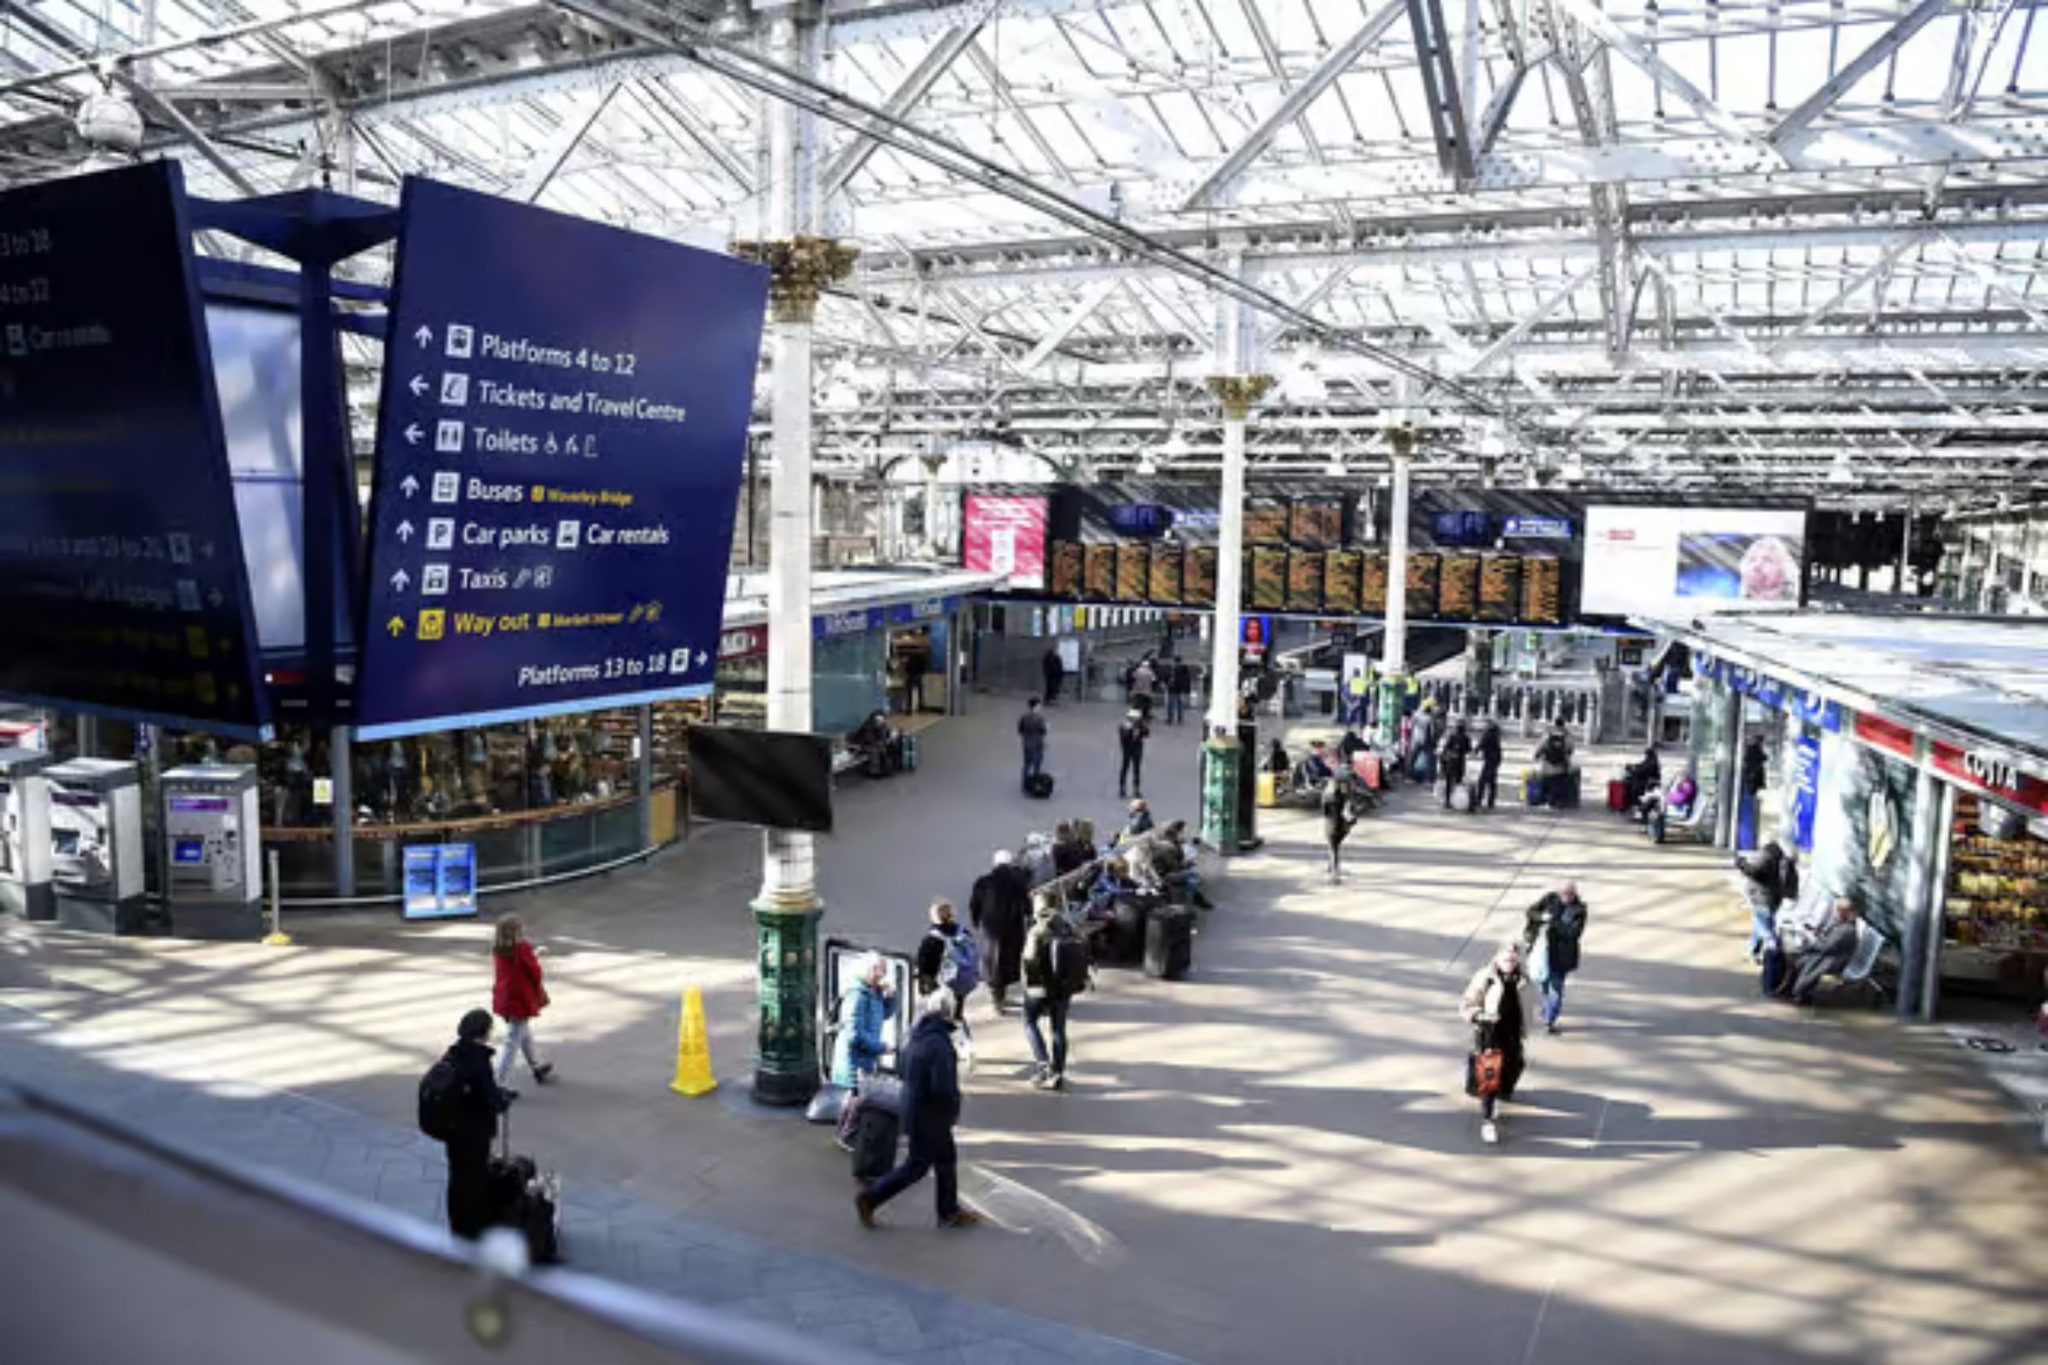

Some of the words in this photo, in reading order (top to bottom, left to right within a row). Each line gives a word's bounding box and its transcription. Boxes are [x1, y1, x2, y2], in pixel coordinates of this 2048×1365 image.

[481, 334, 572, 368] Platforms
[576, 351, 587, 368] 4
[592, 353, 611, 371] to
[615, 354, 636, 375] 12
[479, 380, 545, 409] Tickets
[550, 392, 583, 412] and
[586, 392, 635, 417] Travel
[636, 398, 685, 422] Centre
[474, 427, 538, 453] Toilets
[467, 478, 523, 502] Buses
[463, 522, 496, 544] Car
[499, 524, 549, 548] parks
[587, 524, 614, 544] Car
[617, 525, 669, 544] rentals
[459, 568, 508, 588] Taxis
[454, 613, 496, 636] Way
[499, 613, 530, 630] out
[518, 664, 599, 686] Platforms
[604, 657, 624, 678] 13
[627, 659, 643, 675] to
[647, 653, 666, 672] 18
[1964, 750, 2018, 791] COSTA
